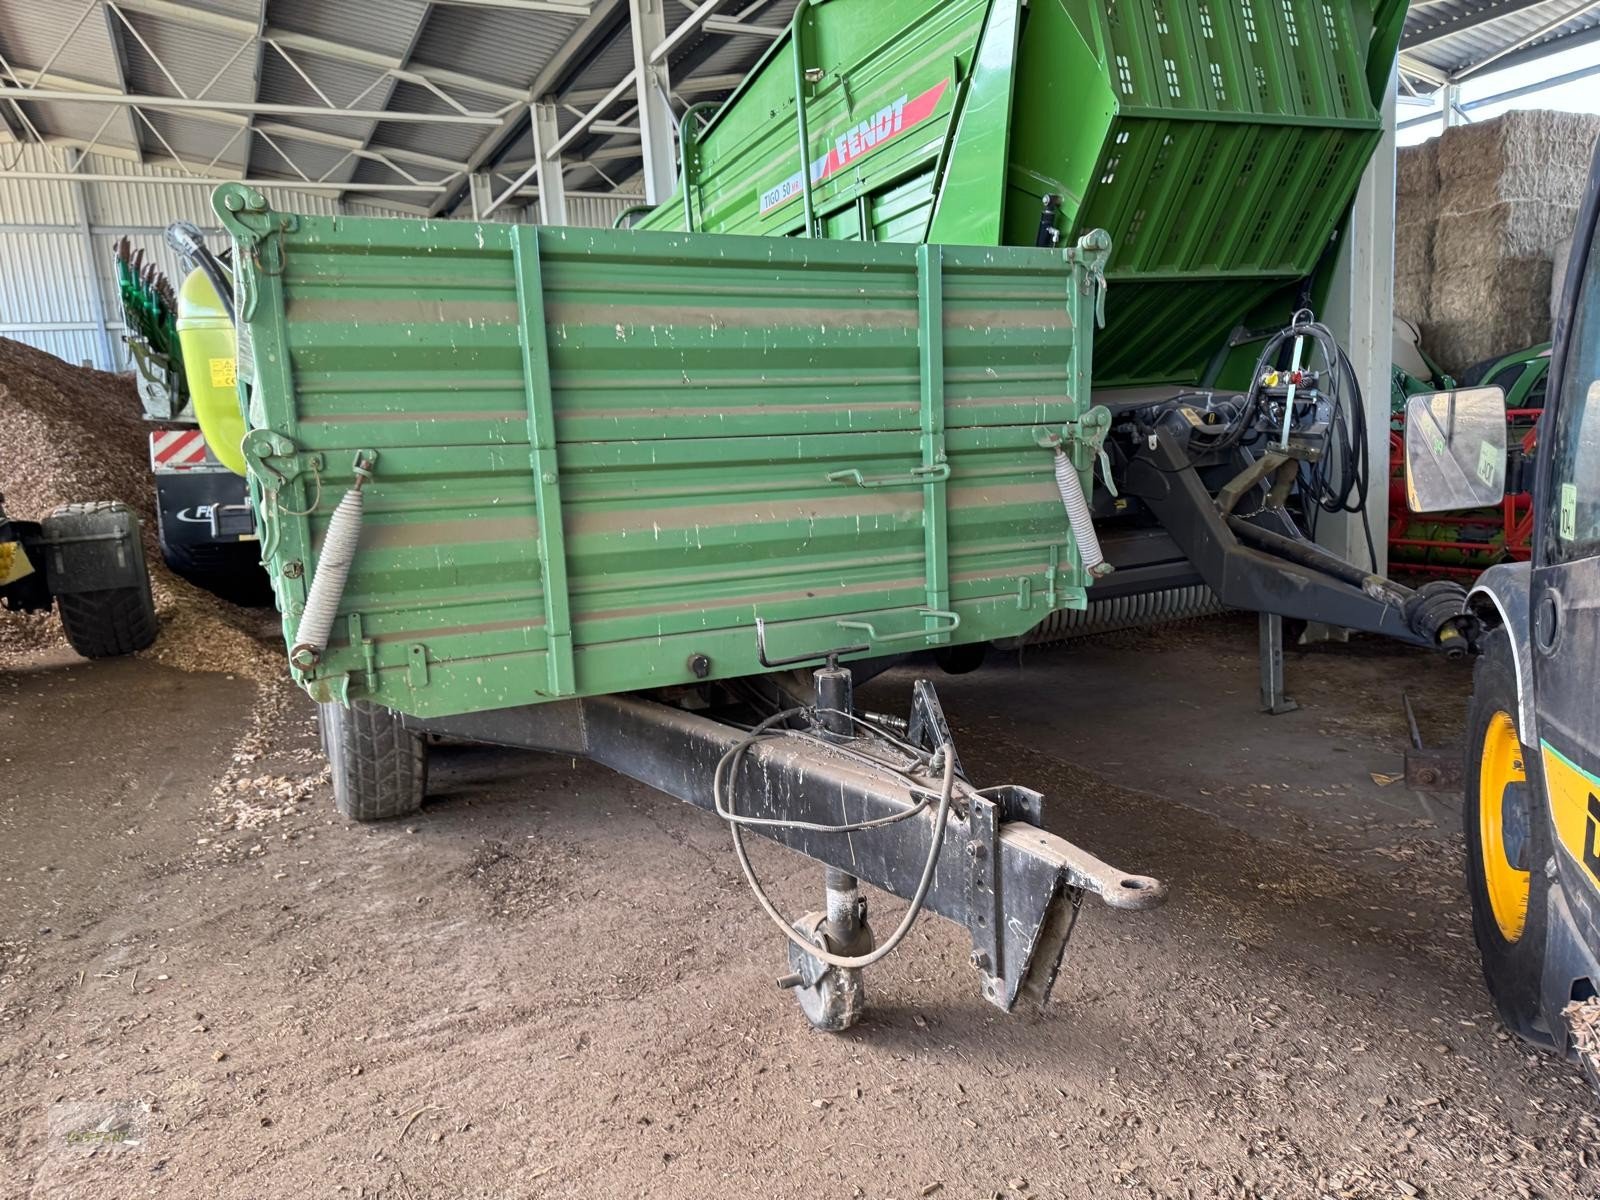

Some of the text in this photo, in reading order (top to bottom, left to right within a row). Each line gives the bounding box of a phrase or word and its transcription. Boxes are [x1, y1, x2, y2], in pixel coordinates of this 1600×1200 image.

[835, 94, 908, 165] FENDT
[764, 189, 780, 209] TIGO
[782, 182, 791, 198] 50
